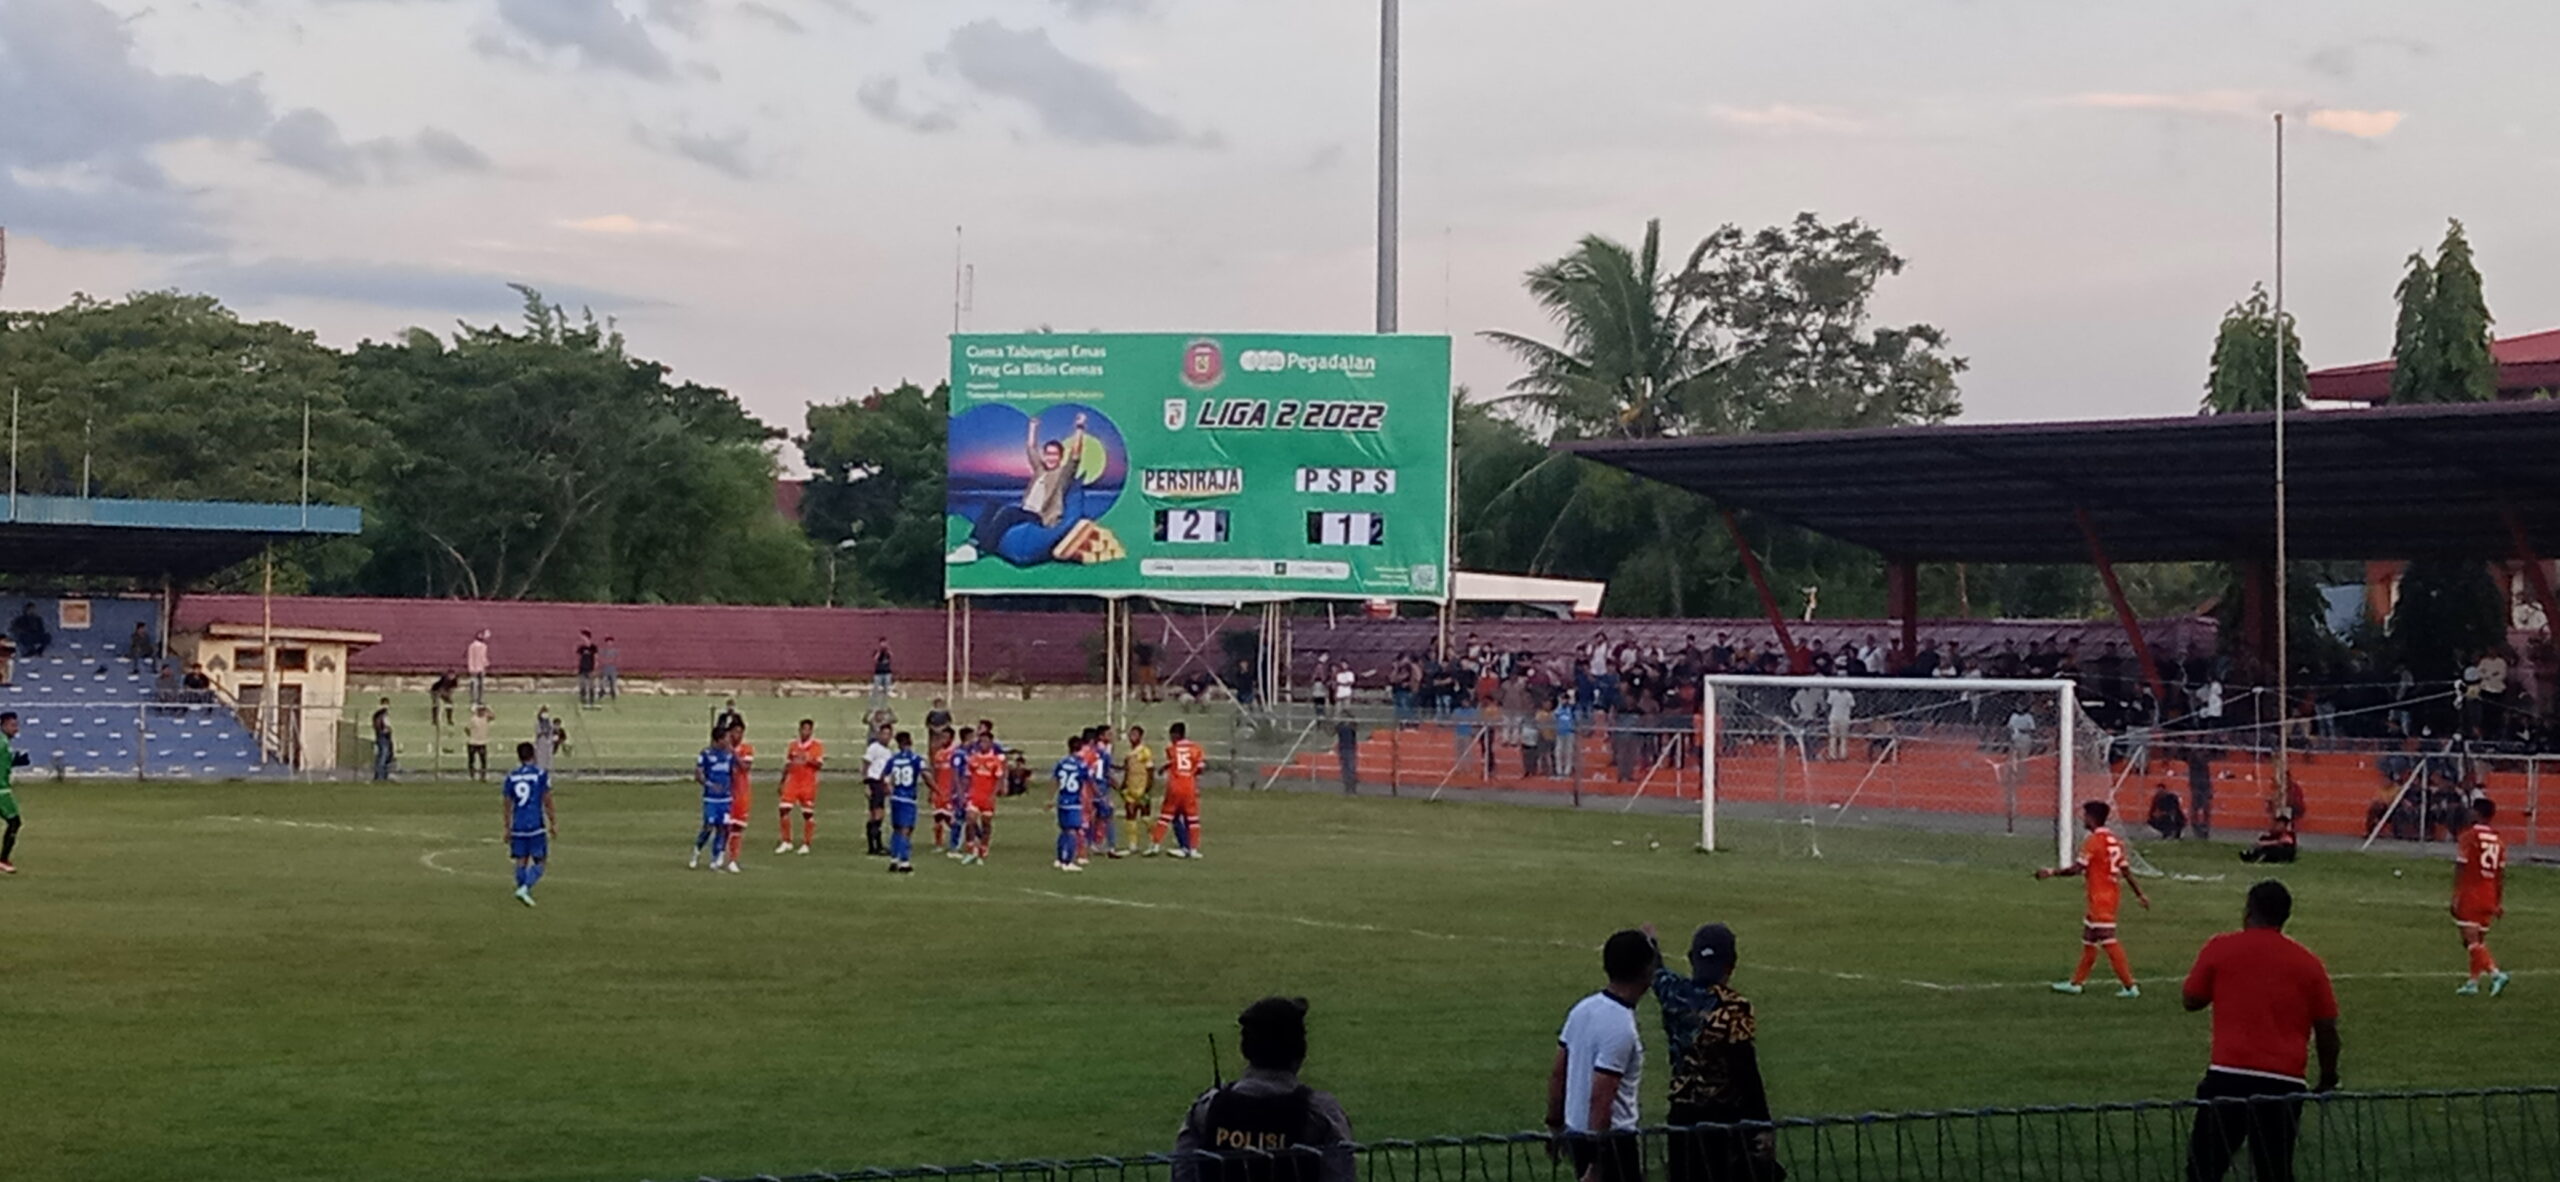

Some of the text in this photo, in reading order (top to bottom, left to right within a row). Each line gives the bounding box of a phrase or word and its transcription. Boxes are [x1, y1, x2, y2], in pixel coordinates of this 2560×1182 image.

[967, 362, 1000, 378] Yang
[1002, 362, 1021, 376] Ga
[1197, 400, 1386, 430] LIGA 2 2022
[1144, 468, 1240, 491] PERSIRAJA
[1183, 509, 1202, 541] 2
[514, 781, 531, 807] 9
[1216, 1127, 1286, 1150] POLISI
